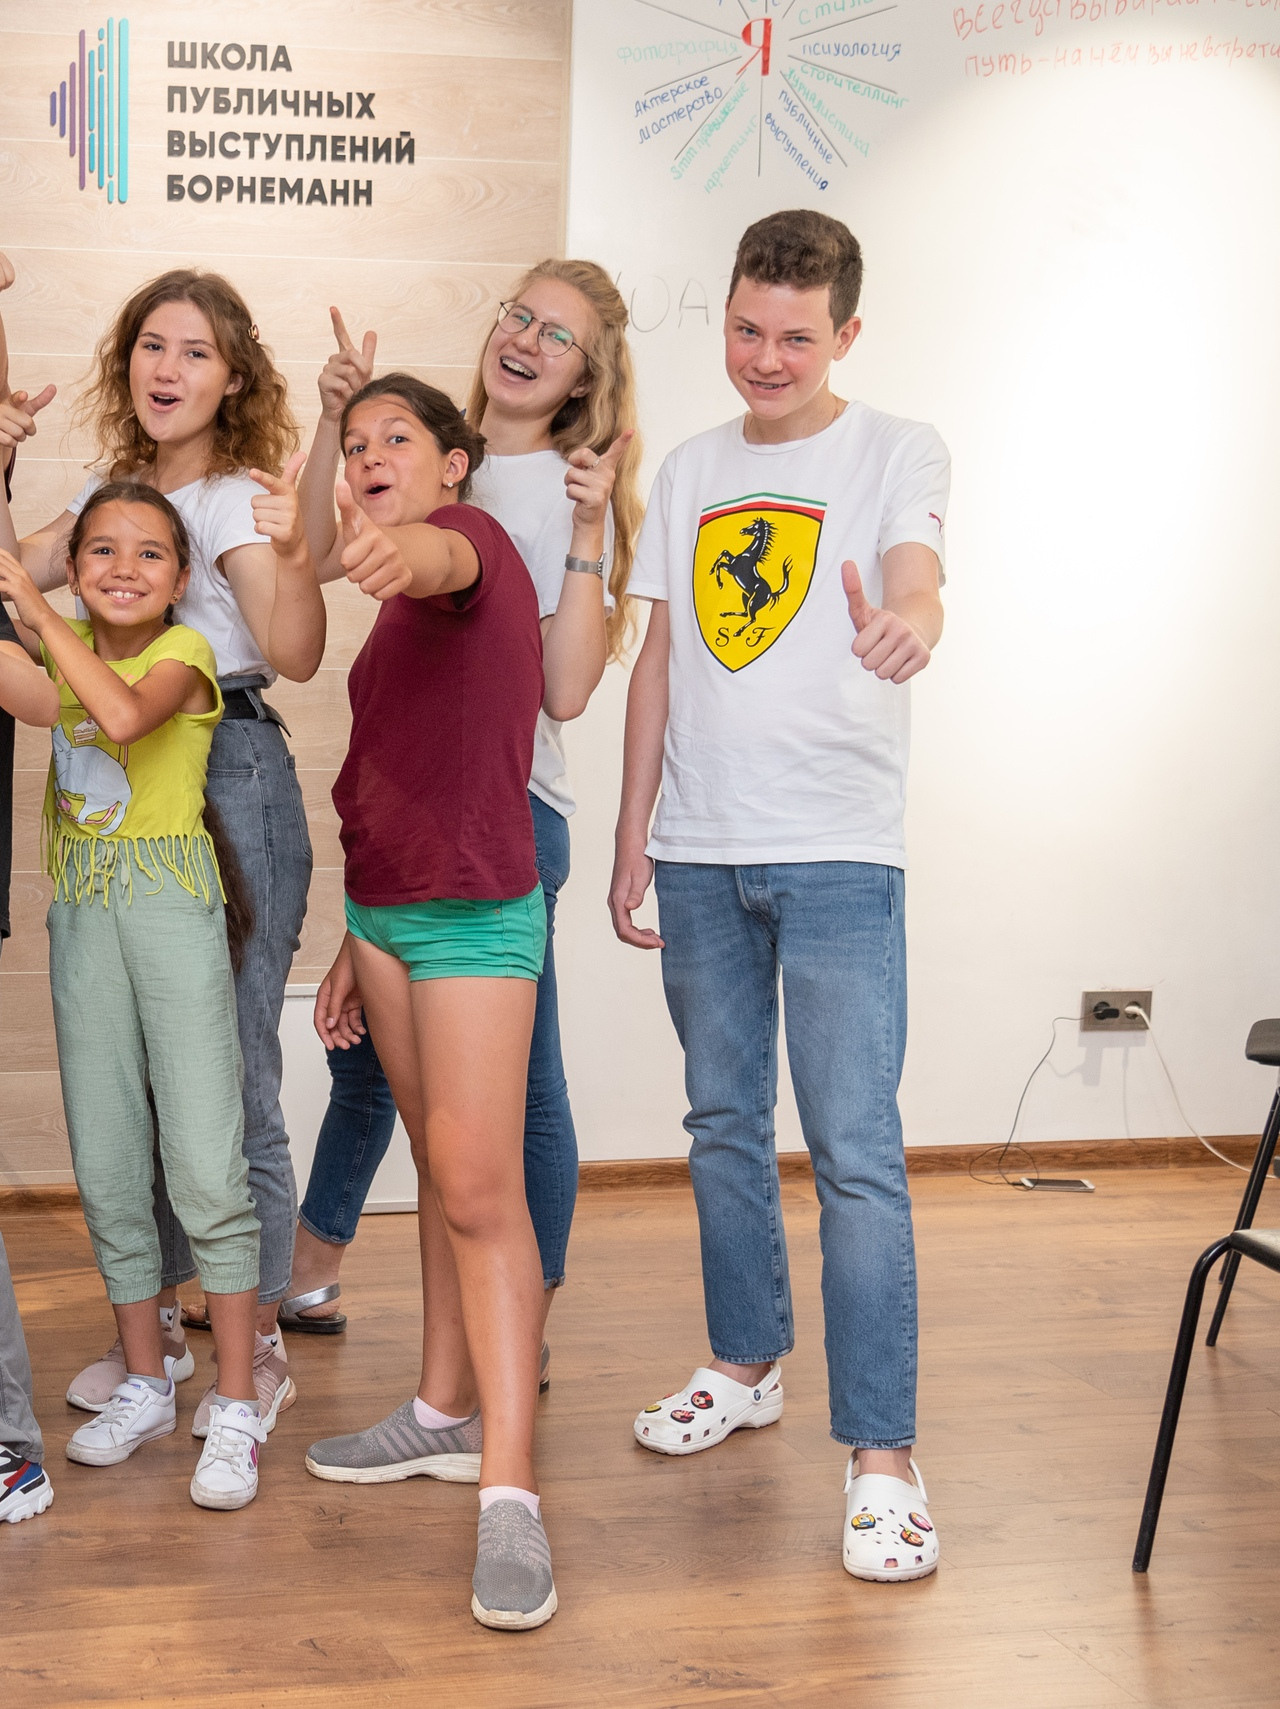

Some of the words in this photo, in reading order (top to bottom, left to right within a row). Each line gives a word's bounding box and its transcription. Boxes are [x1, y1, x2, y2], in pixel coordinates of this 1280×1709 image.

[167, 40, 293, 72] ШКОЛА
[735, 17, 773, 77] Я
[167, 85, 376, 119] ПУБЛИЧНЫХ
[167, 129, 416, 165] ВЫСТУПЛЕНИЙ
[167, 173, 373, 207] БОРНЕМАНН
